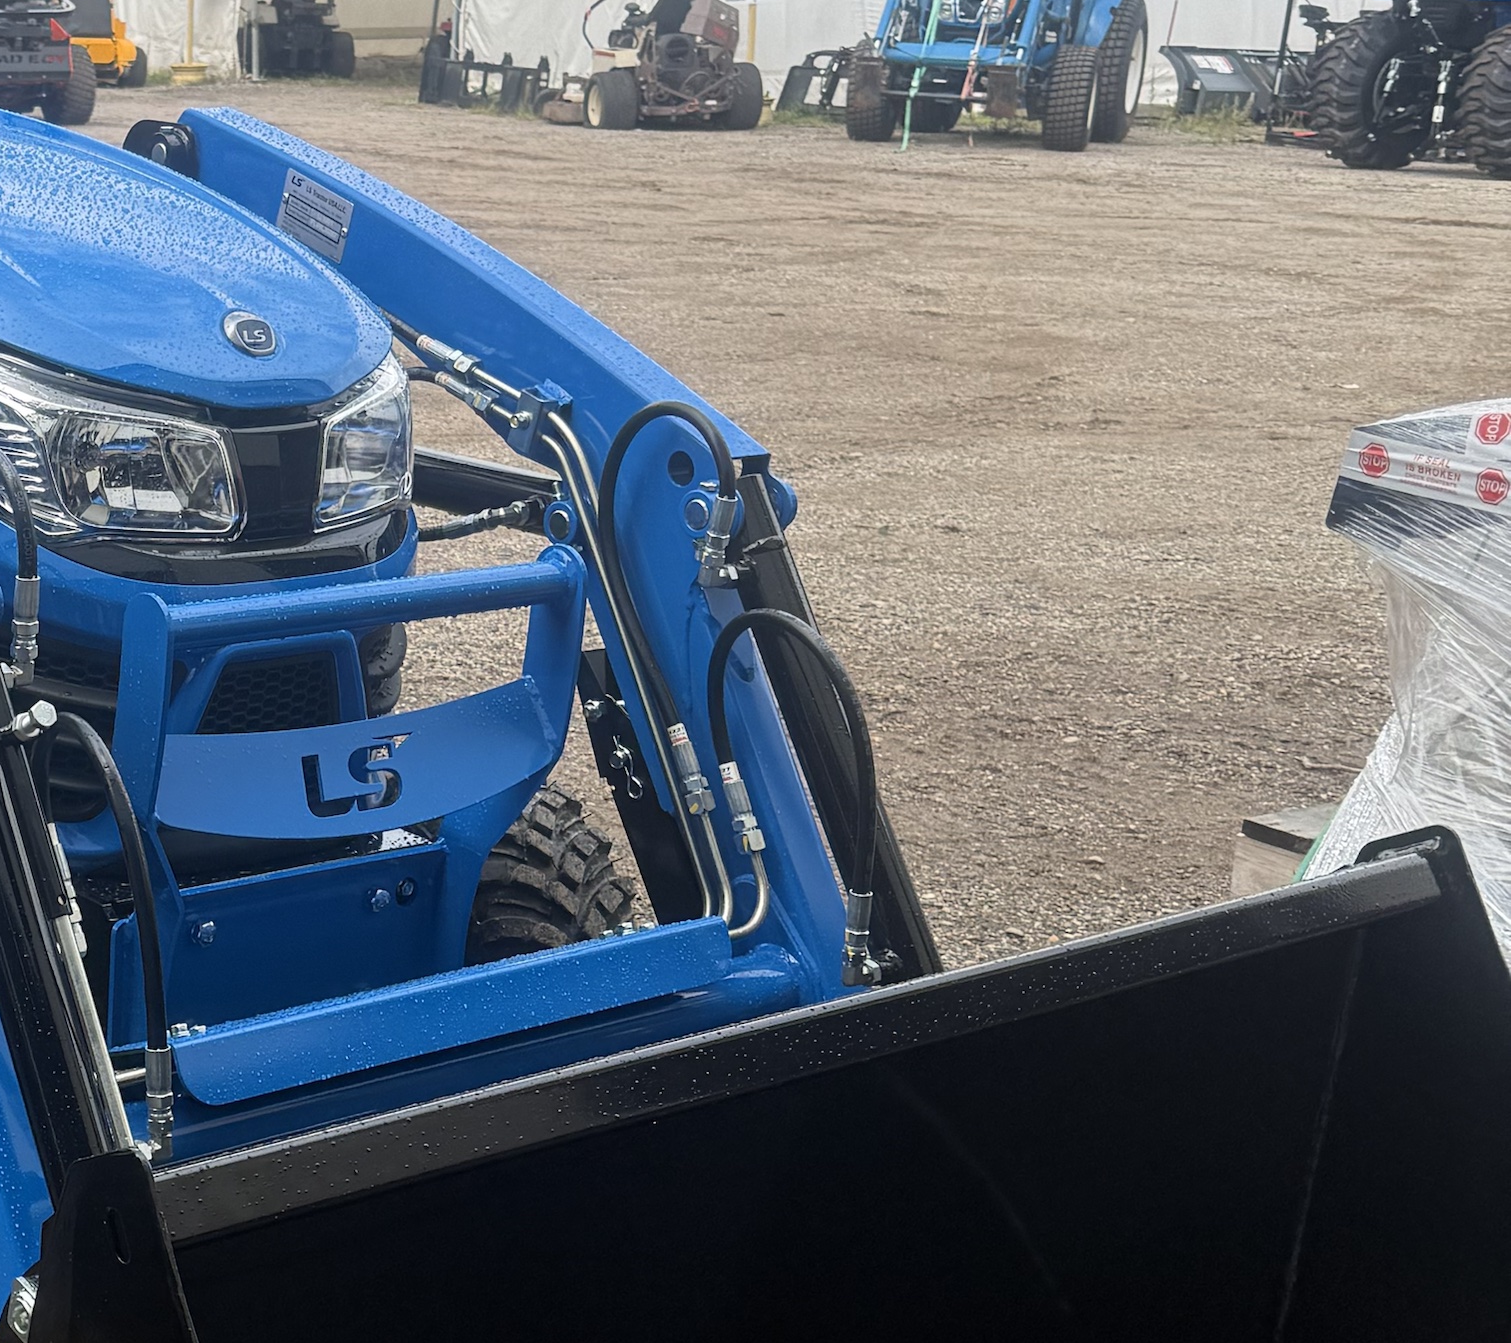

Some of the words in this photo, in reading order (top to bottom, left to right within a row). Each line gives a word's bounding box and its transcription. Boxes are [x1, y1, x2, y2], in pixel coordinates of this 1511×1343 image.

[242, 329, 267, 343] LS
[1485, 413, 1503, 441] STOP
[1362, 454, 1388, 468] STOP
[1417, 465, 1462, 482] BROKEN
[1479, 478, 1507, 494] STOP
[301, 739, 405, 817] LS
